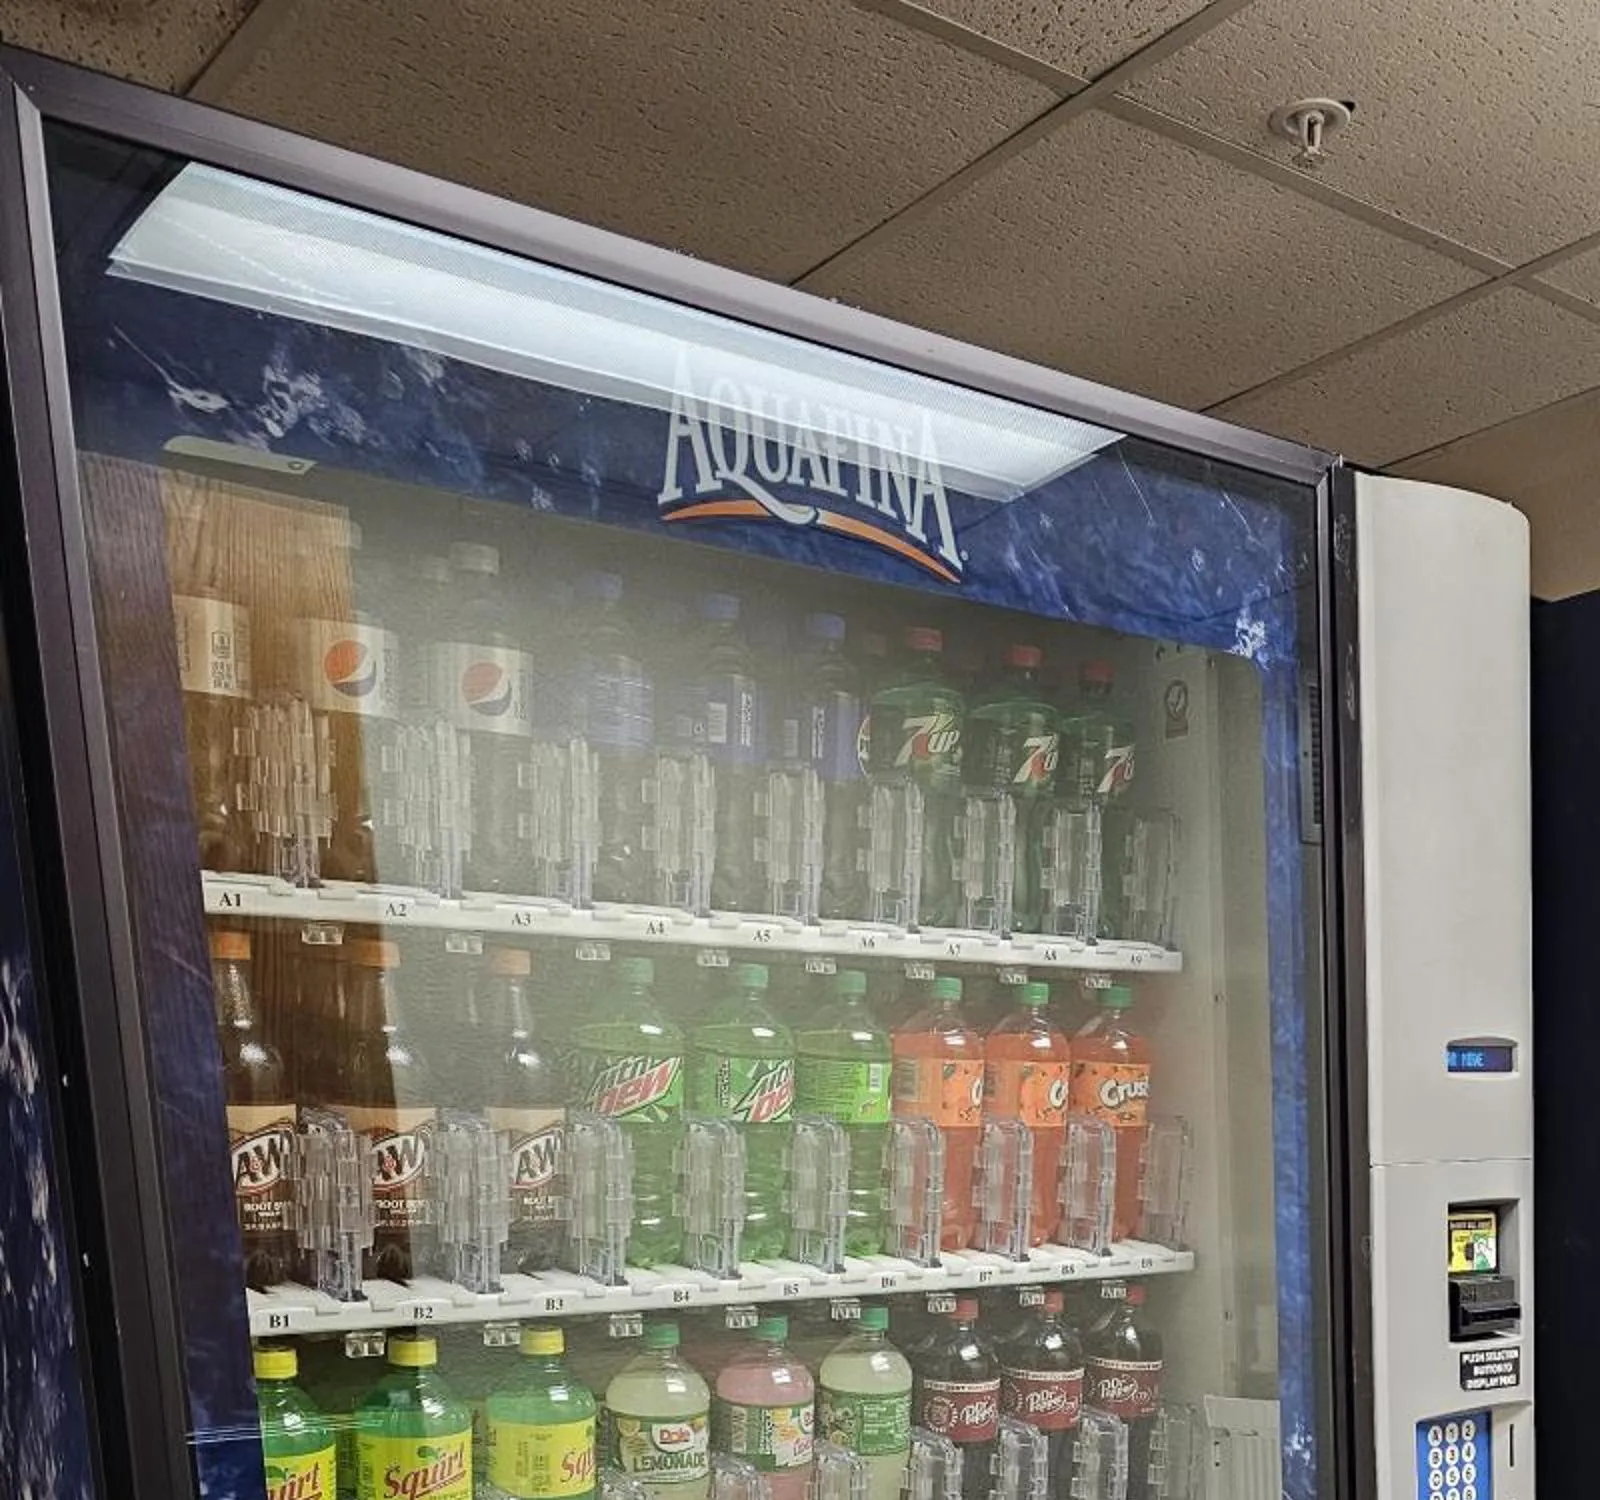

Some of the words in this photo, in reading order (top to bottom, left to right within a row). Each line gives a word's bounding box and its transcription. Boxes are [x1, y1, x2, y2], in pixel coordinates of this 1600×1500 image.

[657, 352, 963, 573] AQUAFINA
[218, 892, 242, 908] A1
[385, 902, 407, 917] A2
[511, 911, 532, 926] A3
[646, 919, 665, 935] A4
[752, 929, 771, 942] A5
[413, 1306, 433, 1319] B2
[269, 1313, 290, 1328] B1
[632, 1451, 706, 1473] LEMONADE
